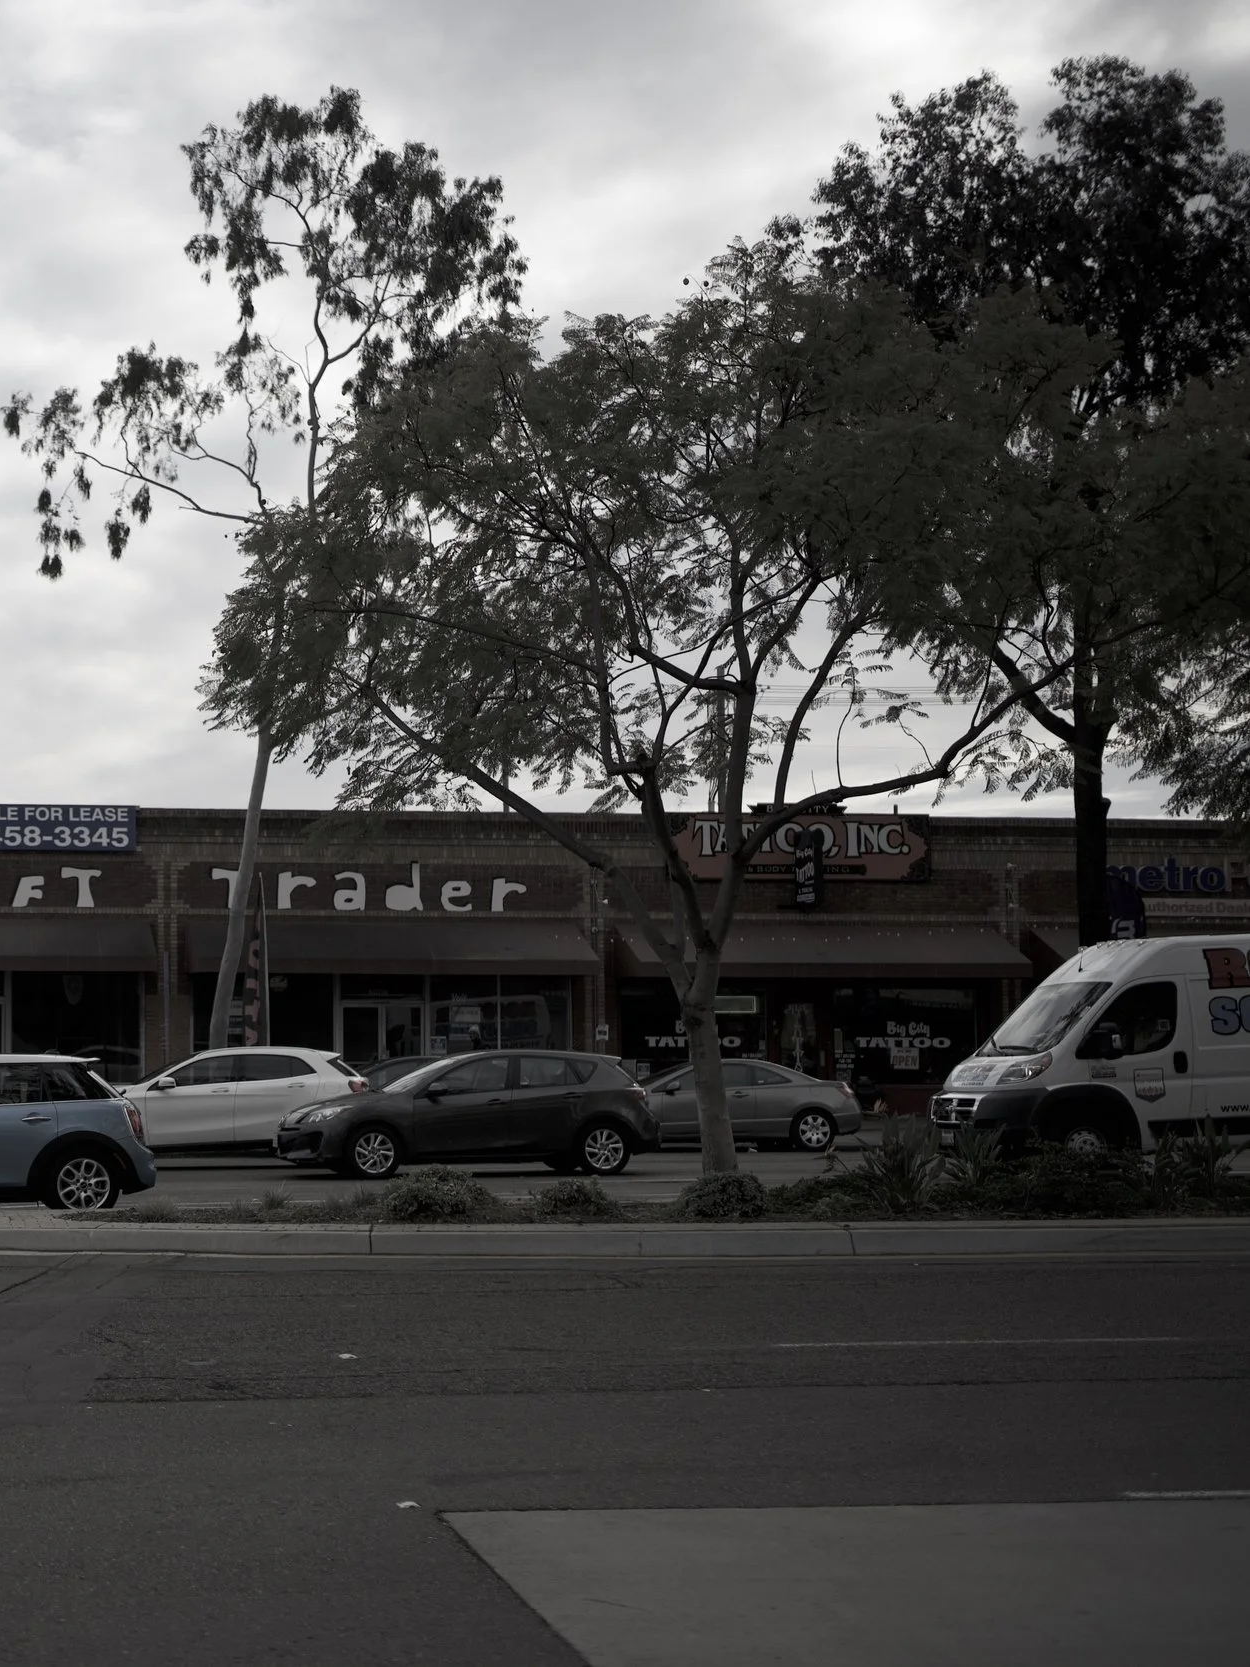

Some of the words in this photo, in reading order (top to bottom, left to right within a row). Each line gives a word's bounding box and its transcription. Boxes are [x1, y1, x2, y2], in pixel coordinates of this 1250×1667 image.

[25, 808, 62, 821] FOR
[69, 808, 129, 822] LEASE
[1145, 901, 1214, 914] uthorized
[644, 1036, 742, 1048] TATO
[855, 1036, 952, 1049] TATTOO
[892, 1056, 918, 1067] OPEN
